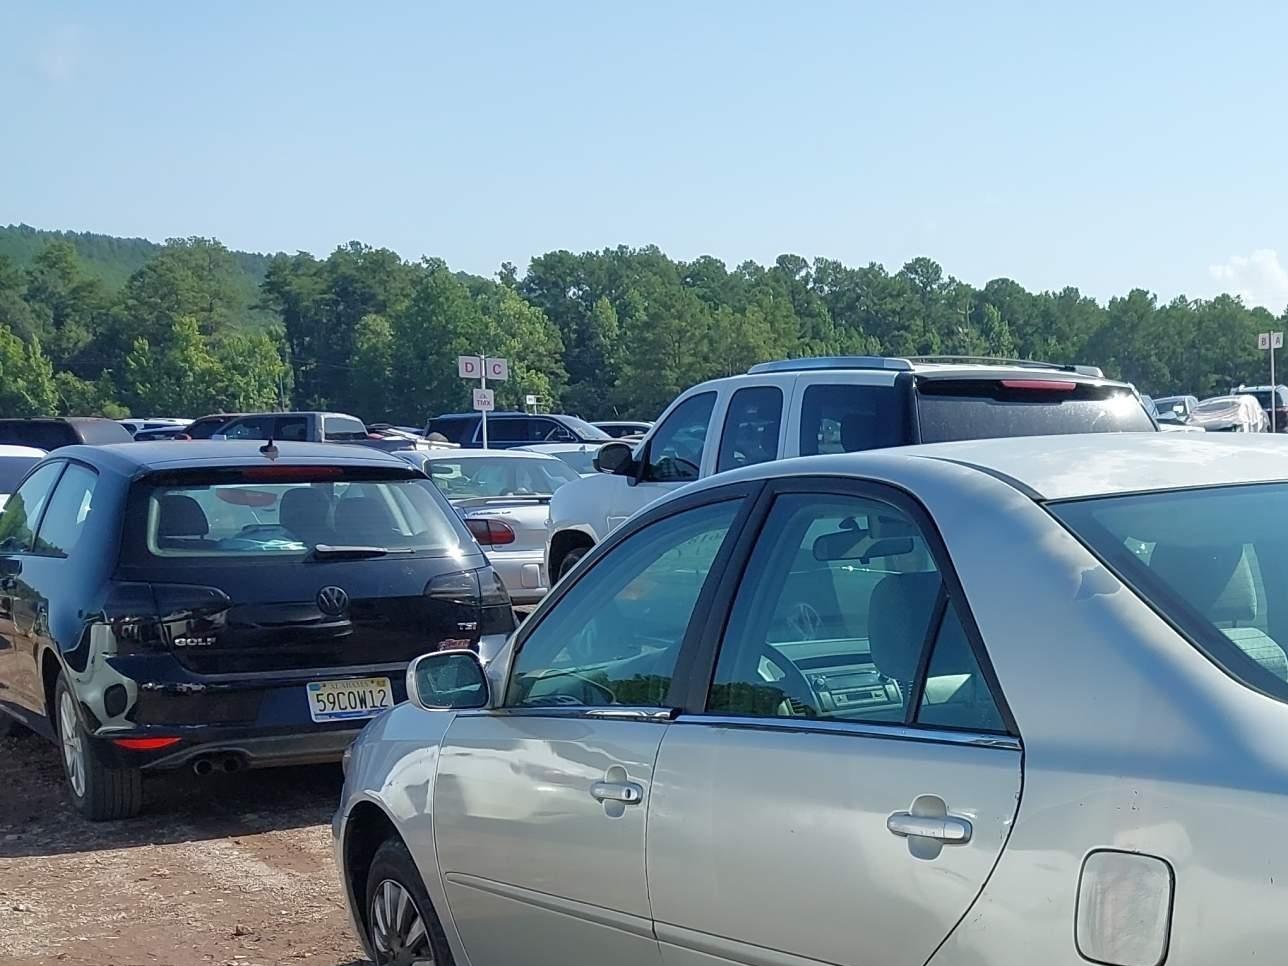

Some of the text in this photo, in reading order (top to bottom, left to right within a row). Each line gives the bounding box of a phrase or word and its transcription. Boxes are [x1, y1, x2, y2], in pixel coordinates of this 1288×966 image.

[465, 362, 475, 373] D
[493, 363, 502, 376] C
[457, 621, 478, 631] TSI
[174, 636, 217, 647] GOLF
